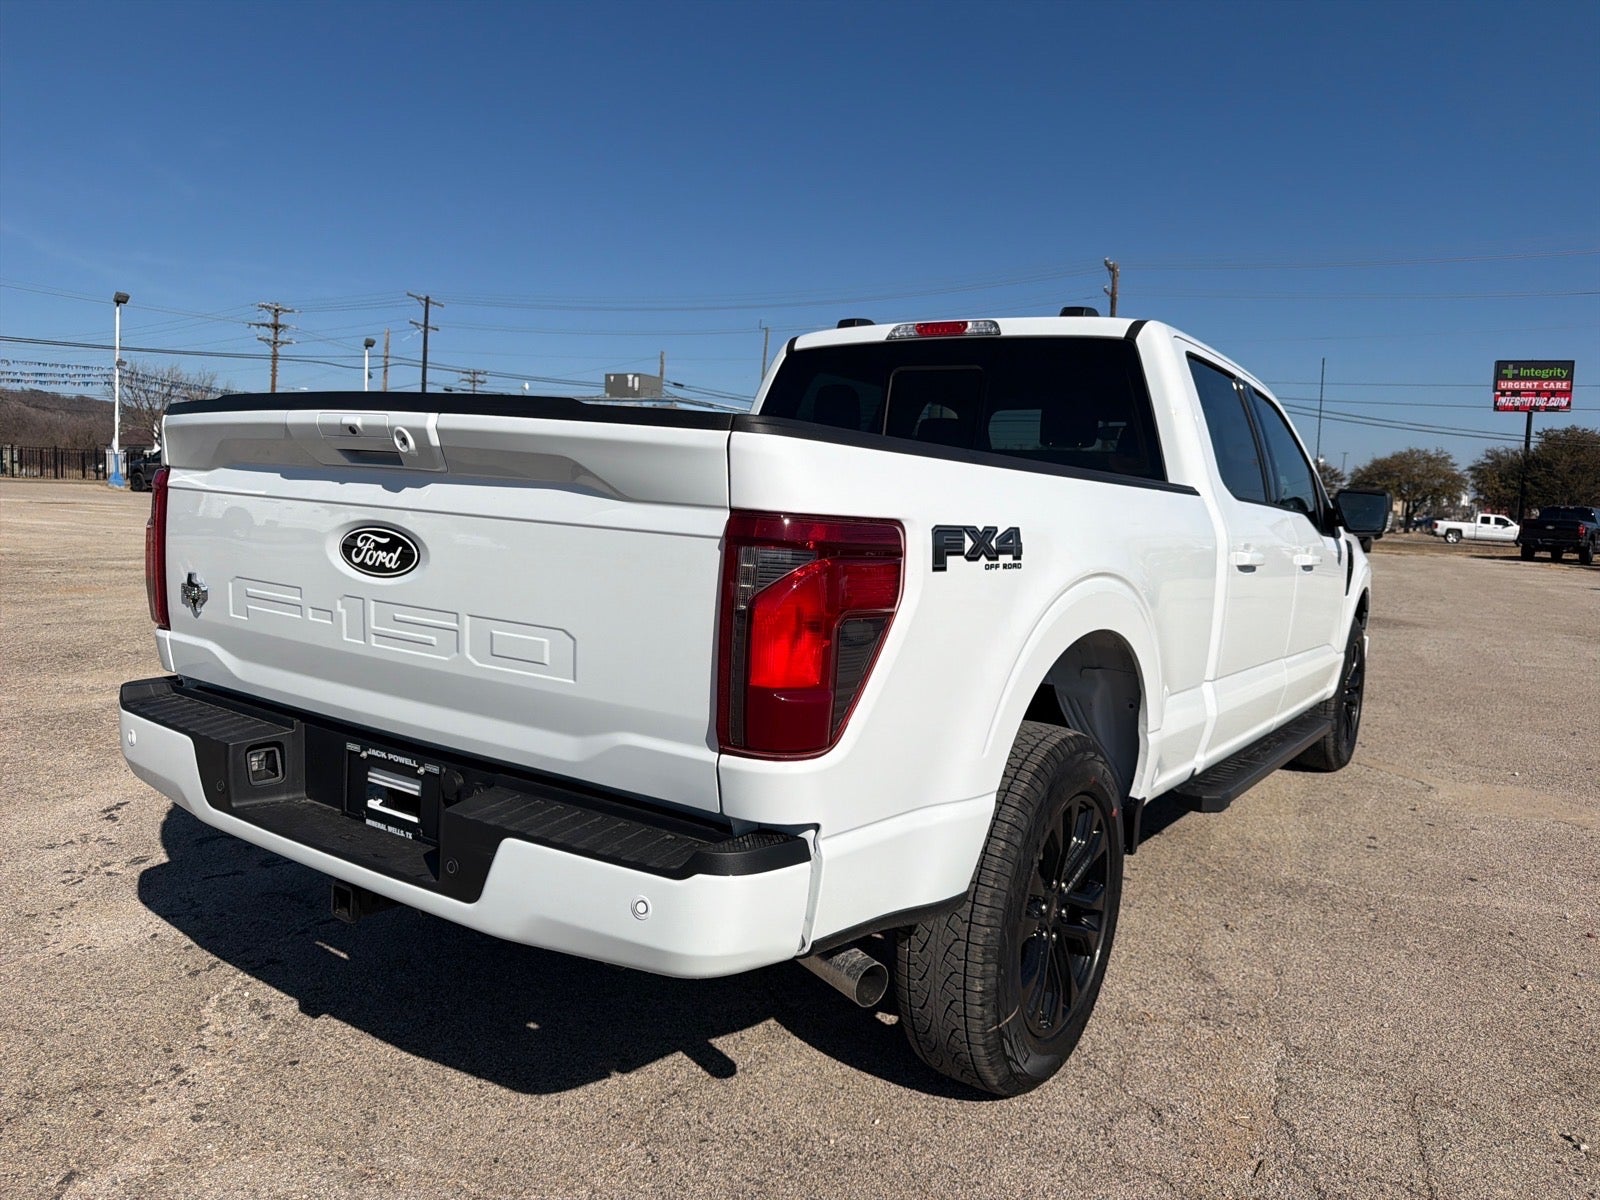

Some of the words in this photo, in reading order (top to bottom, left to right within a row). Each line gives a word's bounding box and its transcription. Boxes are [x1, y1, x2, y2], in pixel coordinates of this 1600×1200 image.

[1520, 367, 1569, 379] Integrity
[1500, 381, 1539, 389] URGENT
[1542, 381, 1568, 389] CARE
[1496, 396, 1570, 407] INTEGRITYUC.COM
[351, 533, 403, 570] Ford
[931, 524, 1023, 573] FX4
[984, 563, 1001, 571] OFF
[1002, 562, 1022, 570] ROAD
[228, 576, 577, 684] F-150
[367, 747, 387, 759] JACK
[387, 752, 419, 768] POWELL
